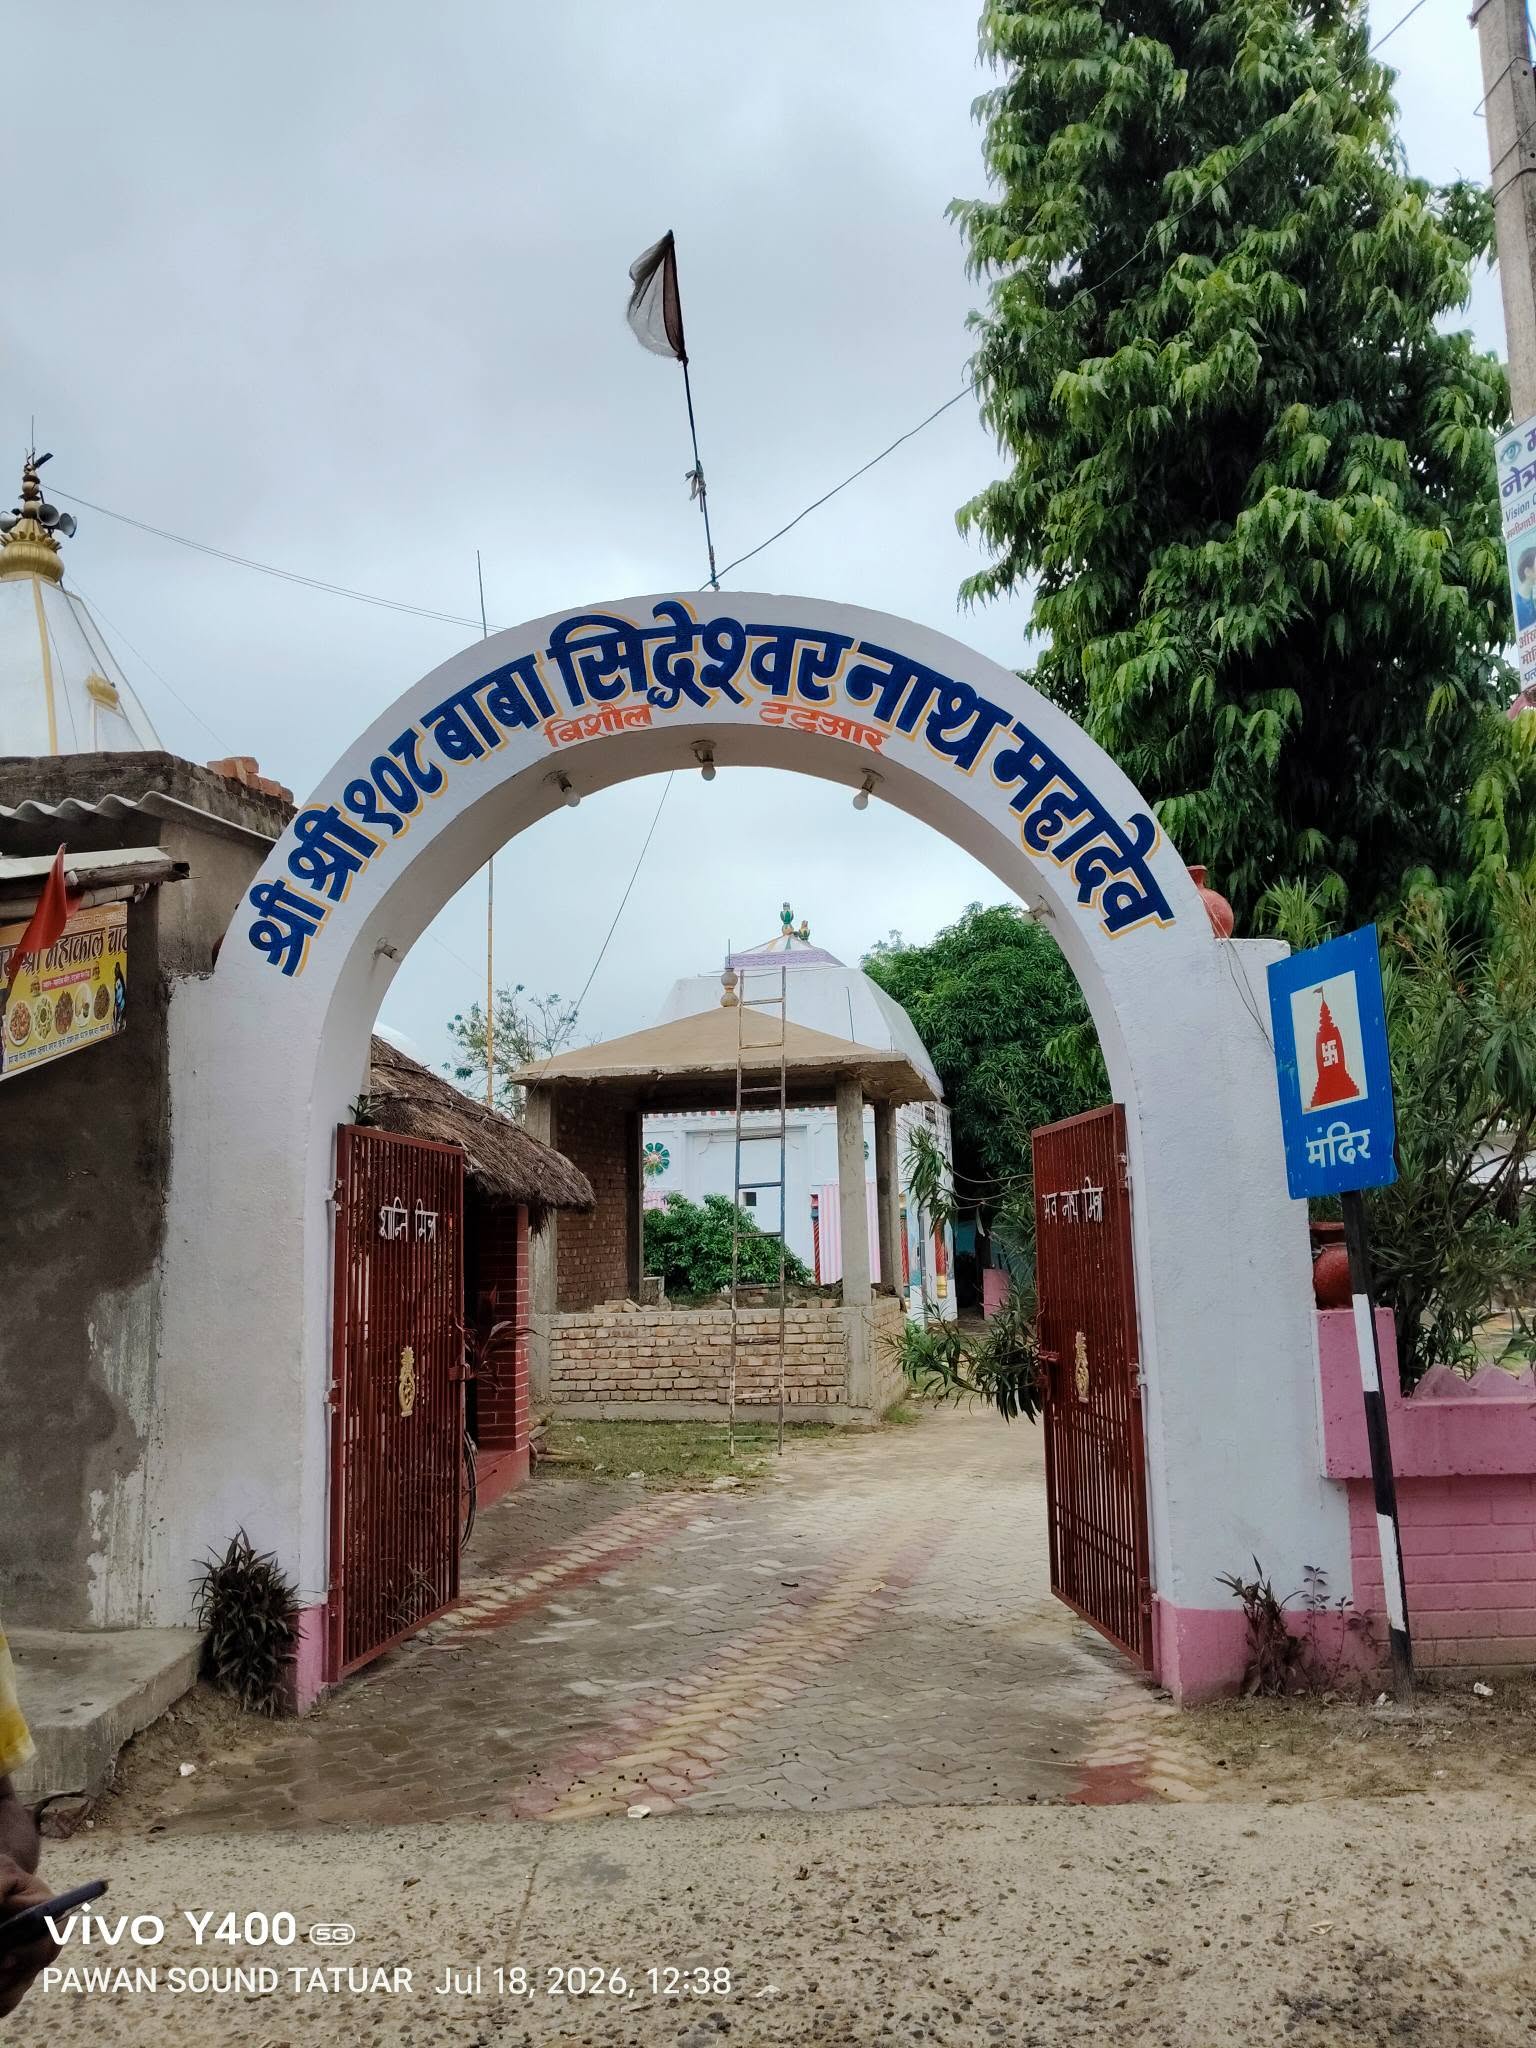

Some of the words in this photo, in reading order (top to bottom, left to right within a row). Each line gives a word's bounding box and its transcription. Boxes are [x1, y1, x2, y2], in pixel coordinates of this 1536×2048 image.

[1505, 500, 1530, 522] Vision
[248, 879, 326, 977] श्री
[287, 806, 379, 902] श्री
[343, 728, 444, 835] १०८
[419, 653, 557, 761] बाबा
[845, 641, 1015, 770] नाथ
[993, 721, 1176, 932] महादेव
[1305, 1121, 1371, 1169] मंदिर
